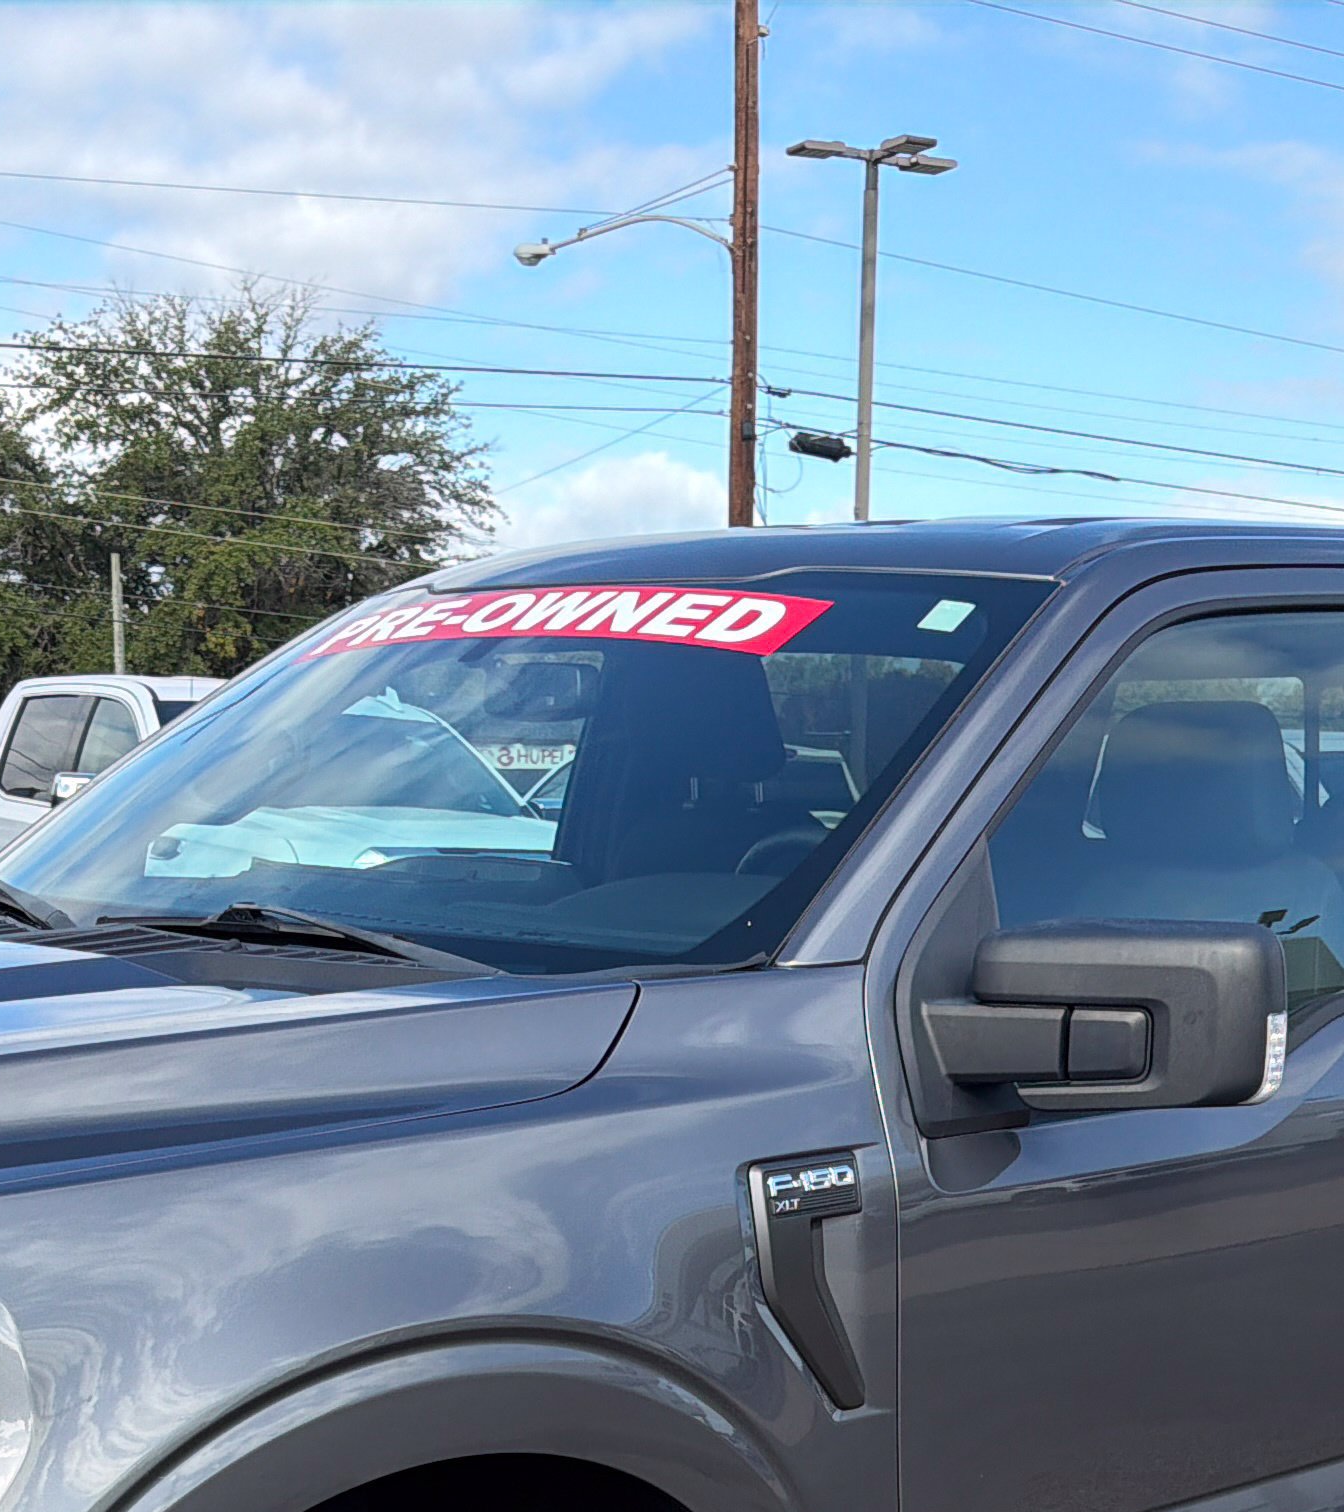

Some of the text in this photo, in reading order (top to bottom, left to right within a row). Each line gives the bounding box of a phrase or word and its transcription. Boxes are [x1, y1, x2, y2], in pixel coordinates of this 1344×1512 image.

[312, 590, 787, 655] PRE-OWNED
[767, 1164, 855, 1197] F-150
[774, 1197, 801, 1213] XLT
